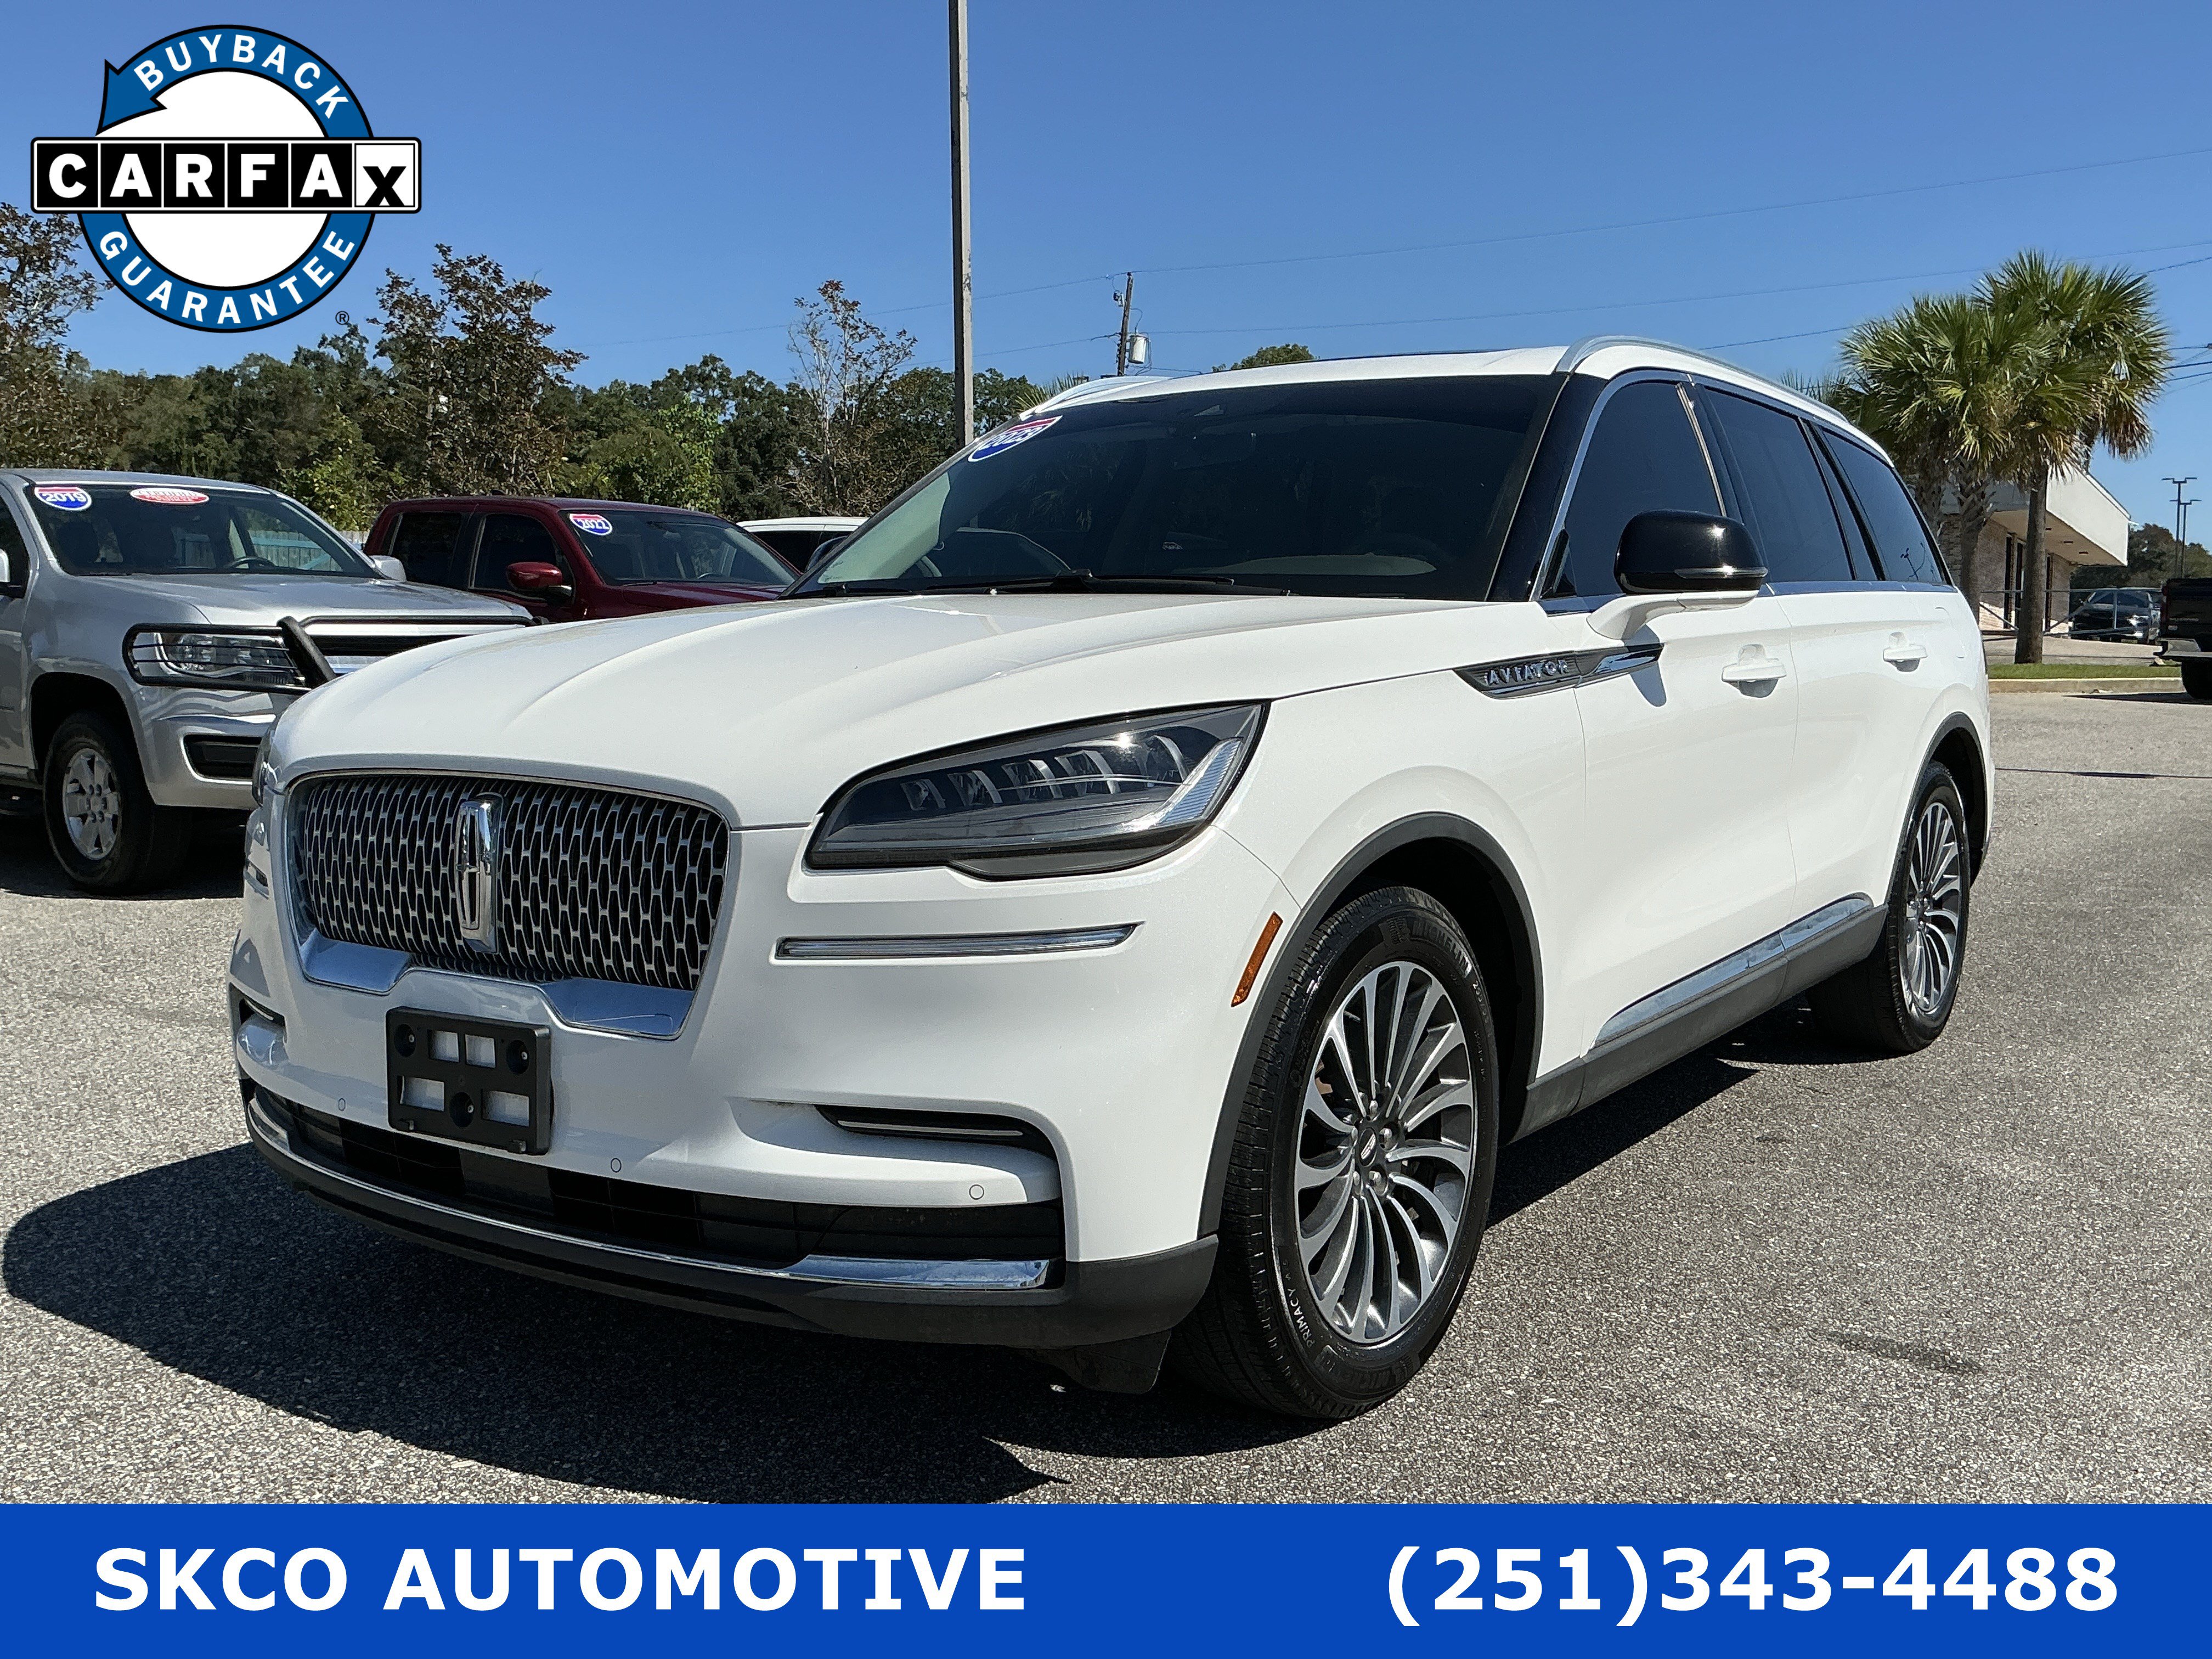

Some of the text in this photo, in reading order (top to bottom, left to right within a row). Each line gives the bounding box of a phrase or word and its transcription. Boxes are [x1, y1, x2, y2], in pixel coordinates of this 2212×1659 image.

[42, 493, 87, 502] 2019
[577, 519, 610, 529] 2022
[1488, 659, 1570, 685] AVIATOR
[1287, 1288, 1315, 1348] PRIMACY
